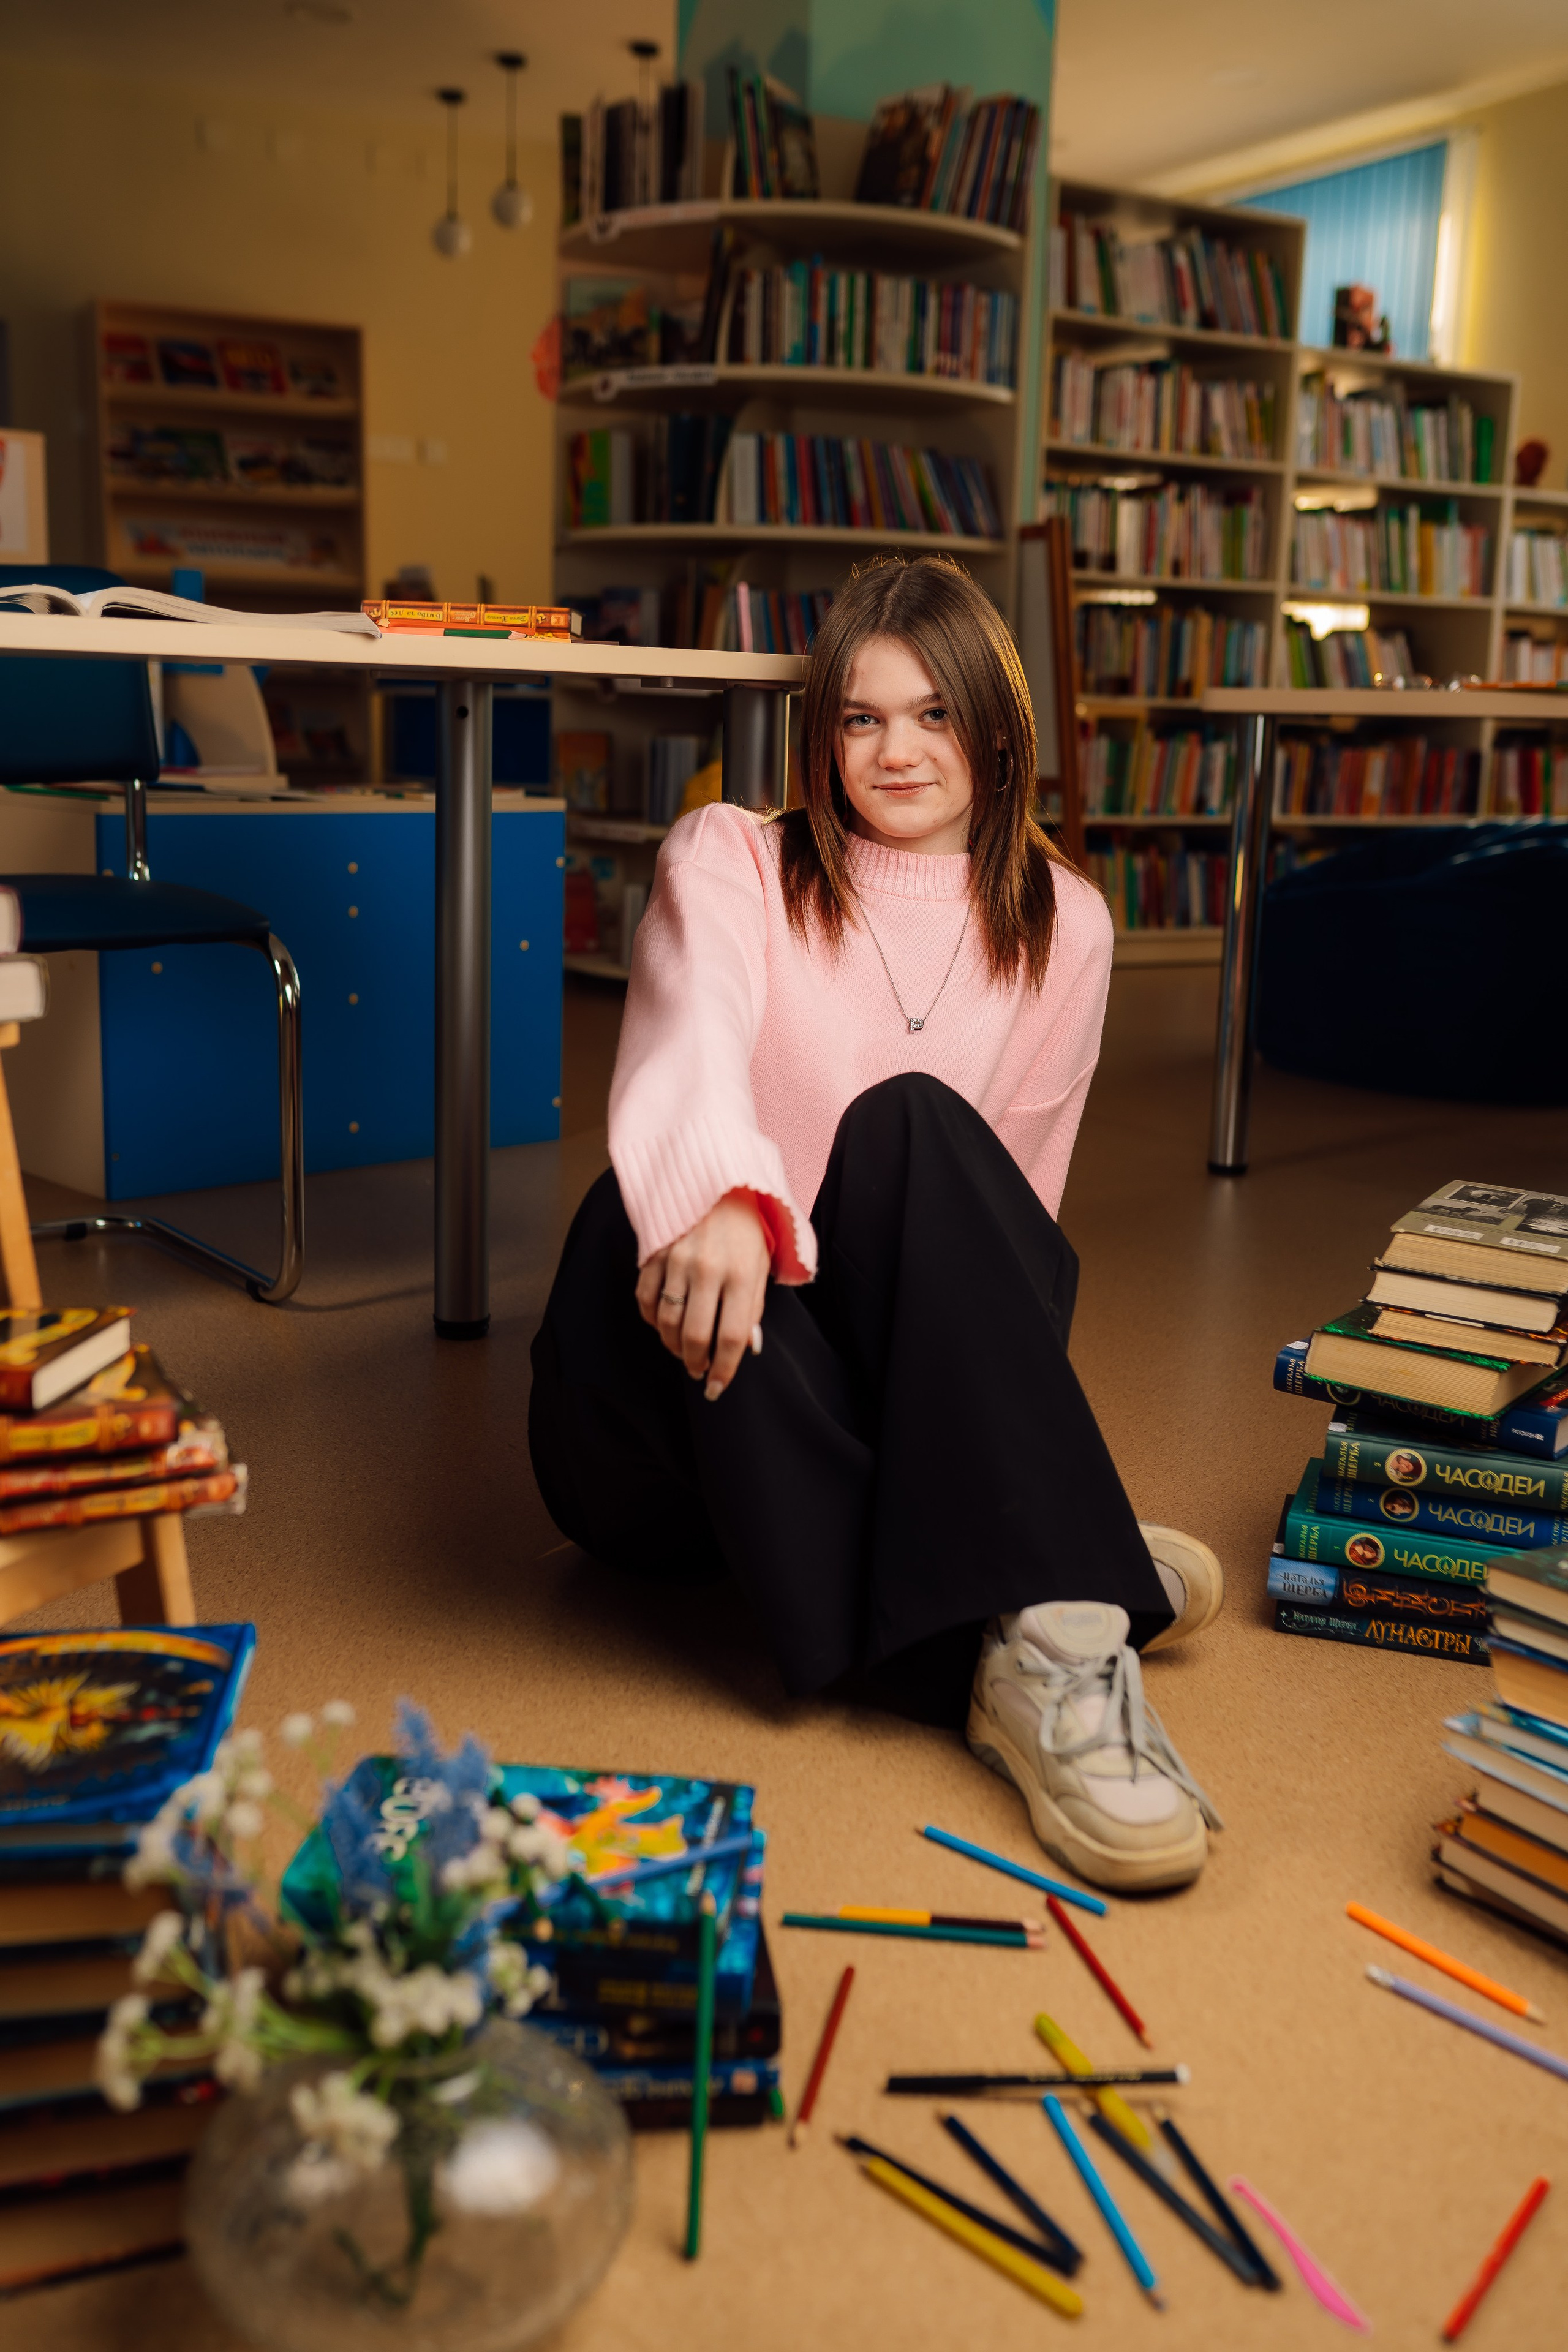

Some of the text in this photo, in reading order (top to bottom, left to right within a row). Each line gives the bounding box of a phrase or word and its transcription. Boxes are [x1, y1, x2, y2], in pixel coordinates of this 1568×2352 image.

[1286, 1357, 1297, 1392] НАТАЛЬЯ
[1294, 1360, 1305, 1395] ЩЕРБА
[1337, 1441, 1349, 1477] НАТАЛЬЯ
[1347, 1442, 1360, 1479] ЩЕРБА
[1434, 1463, 1546, 1498] ЧАСОДЕИ
[1428, 1502, 1536, 1539] ЧАСОДЕИ
[1298, 1524, 1308, 1558] НАТАЛЬЯ
[1308, 1525, 1321, 1561] ЩЕРБА
[1283, 1581, 1328, 1599] ЩЕРБА
[1364, 1618, 1472, 1654] ЛУНАСТРЫ
